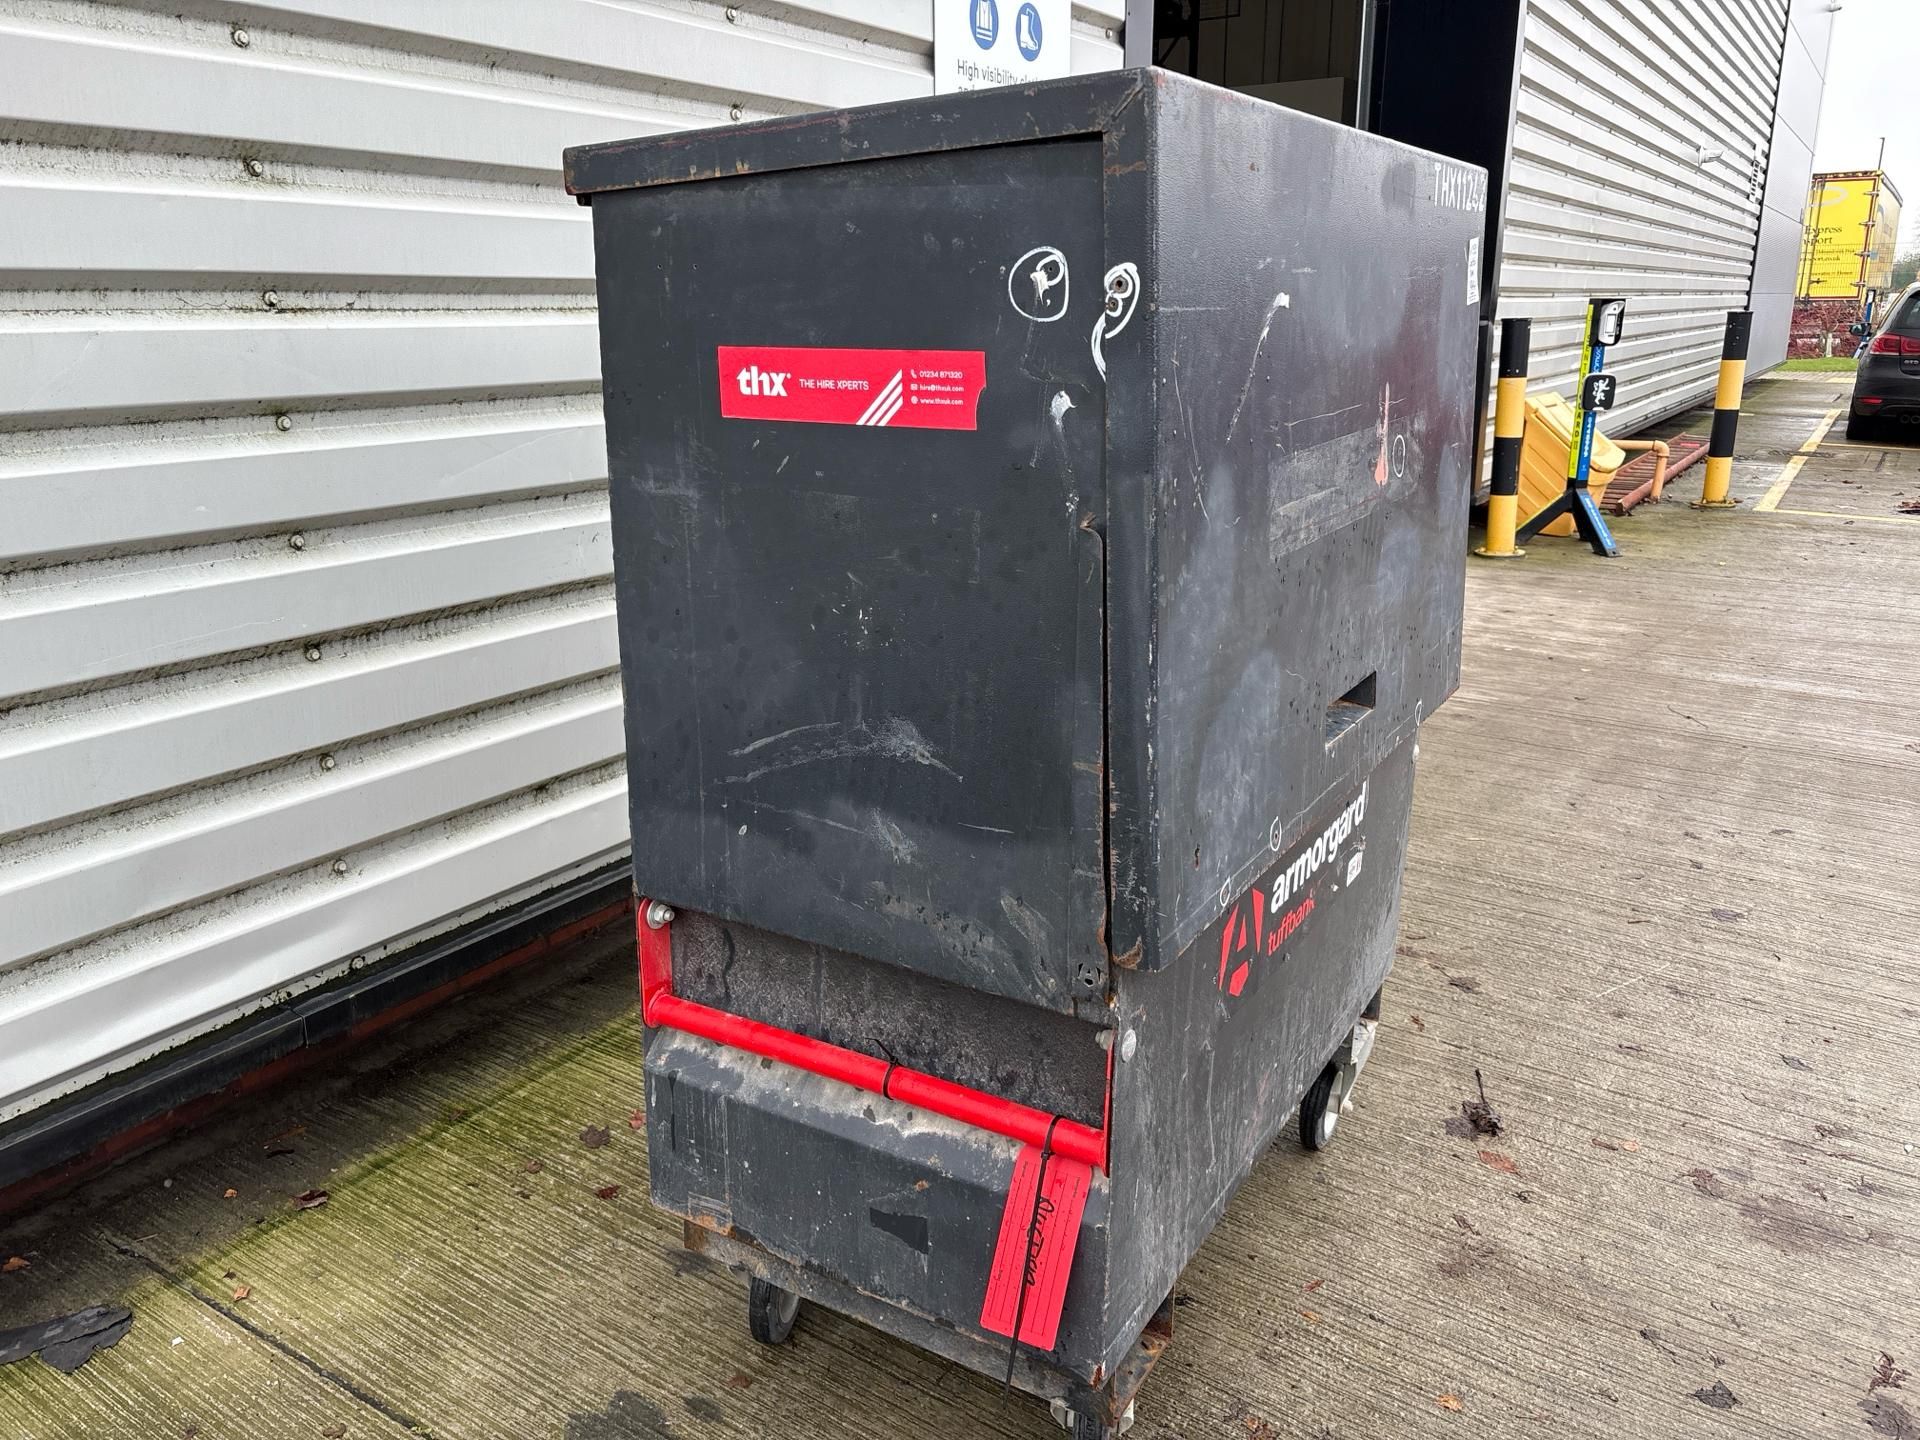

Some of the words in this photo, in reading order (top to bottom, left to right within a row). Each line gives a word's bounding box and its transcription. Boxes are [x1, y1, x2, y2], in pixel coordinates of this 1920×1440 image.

[957, 58, 979, 81] High
[982, 65, 1018, 85] visibility
[736, 365, 788, 397] thx
[799, 378, 816, 389] THE
[816, 379, 835, 390] HIRE
[836, 380, 870, 391] XPERTS
[1270, 780, 1368, 914] armorgard
[1267, 897, 1316, 957] tuffbank
